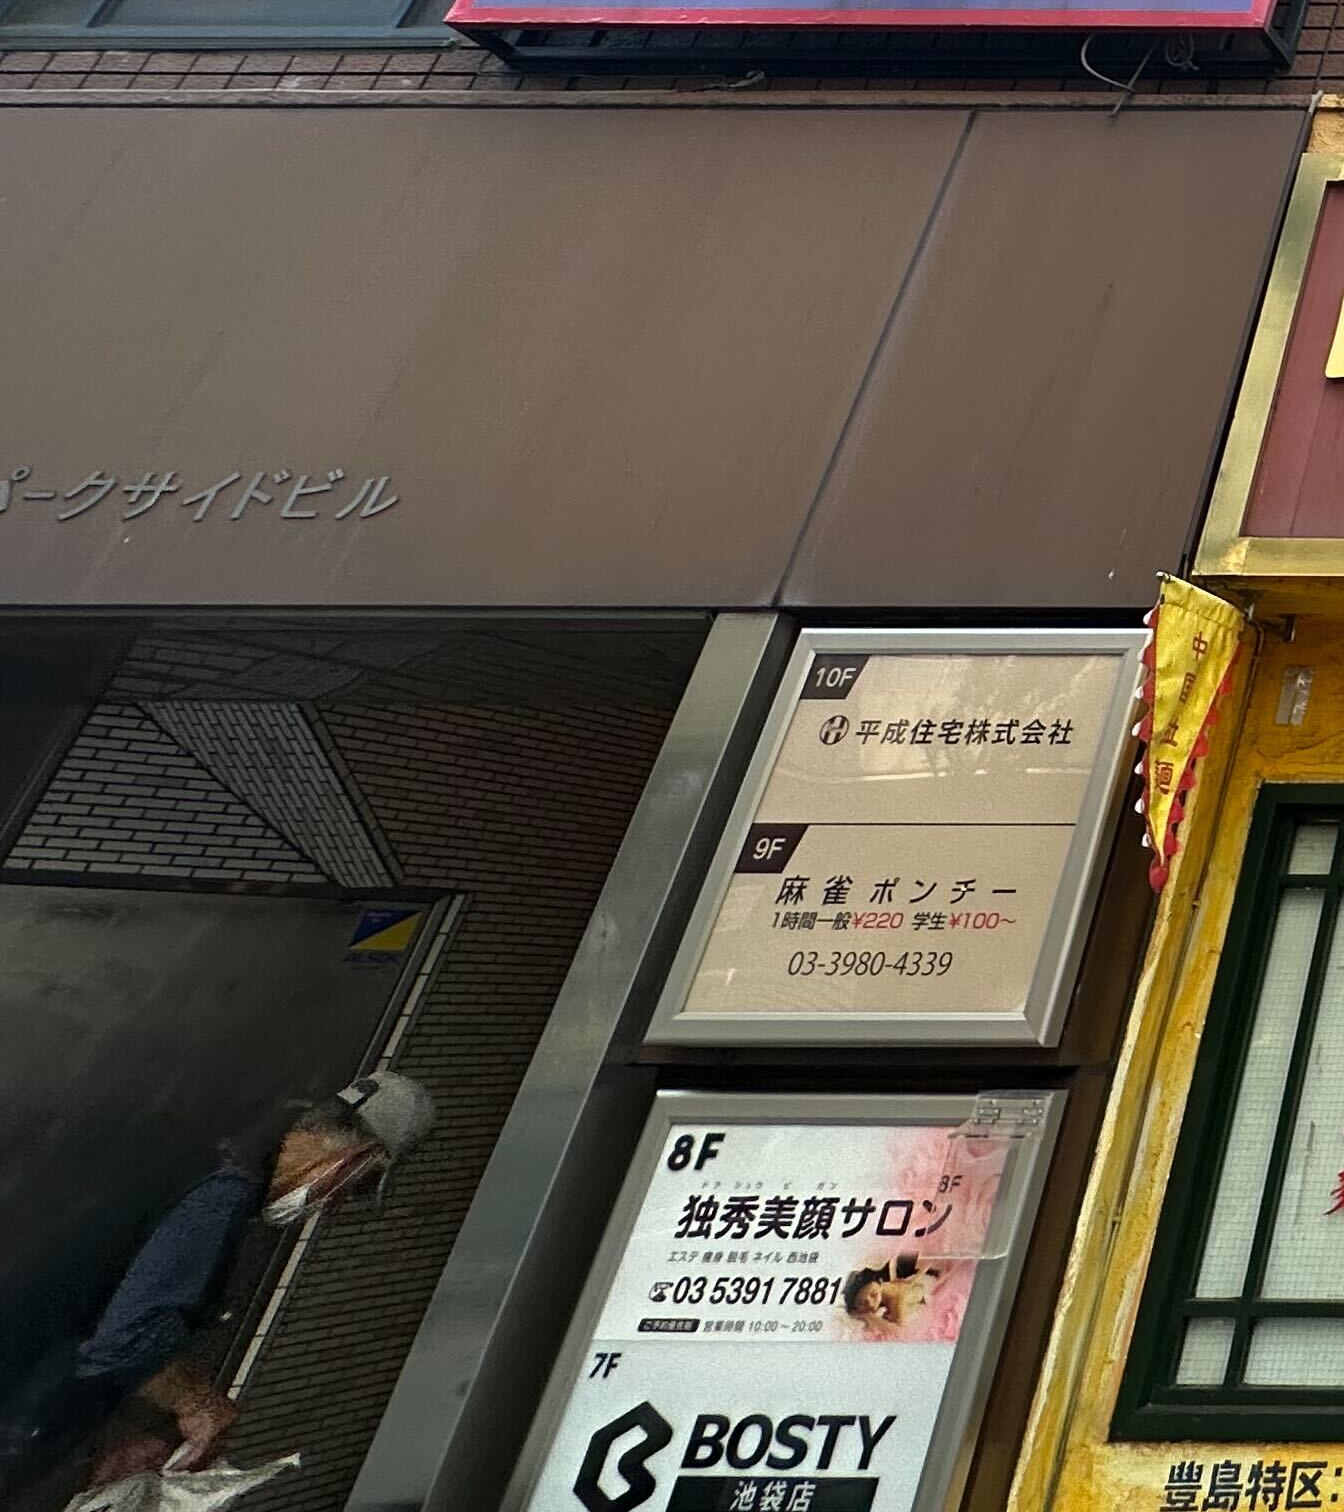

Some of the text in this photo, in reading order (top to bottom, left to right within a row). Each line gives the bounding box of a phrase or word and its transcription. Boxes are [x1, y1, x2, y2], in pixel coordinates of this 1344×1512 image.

[813, 666, 857, 689] 10F
[854, 718, 1075, 746] 平成住宅株式会社
[752, 837, 786, 861] 9F
[786, 950, 954, 978] 03-3980-4339
[666, 1132, 727, 1172] 8F
[674, 1194, 954, 1241] 独秀美顔サロン
[712, 1276, 772, 1305] 5391
[589, 1352, 622, 1380] 7F
[680, 1414, 897, 1471] BOSTY
[730, 1479, 817, 1512] 池袋店
